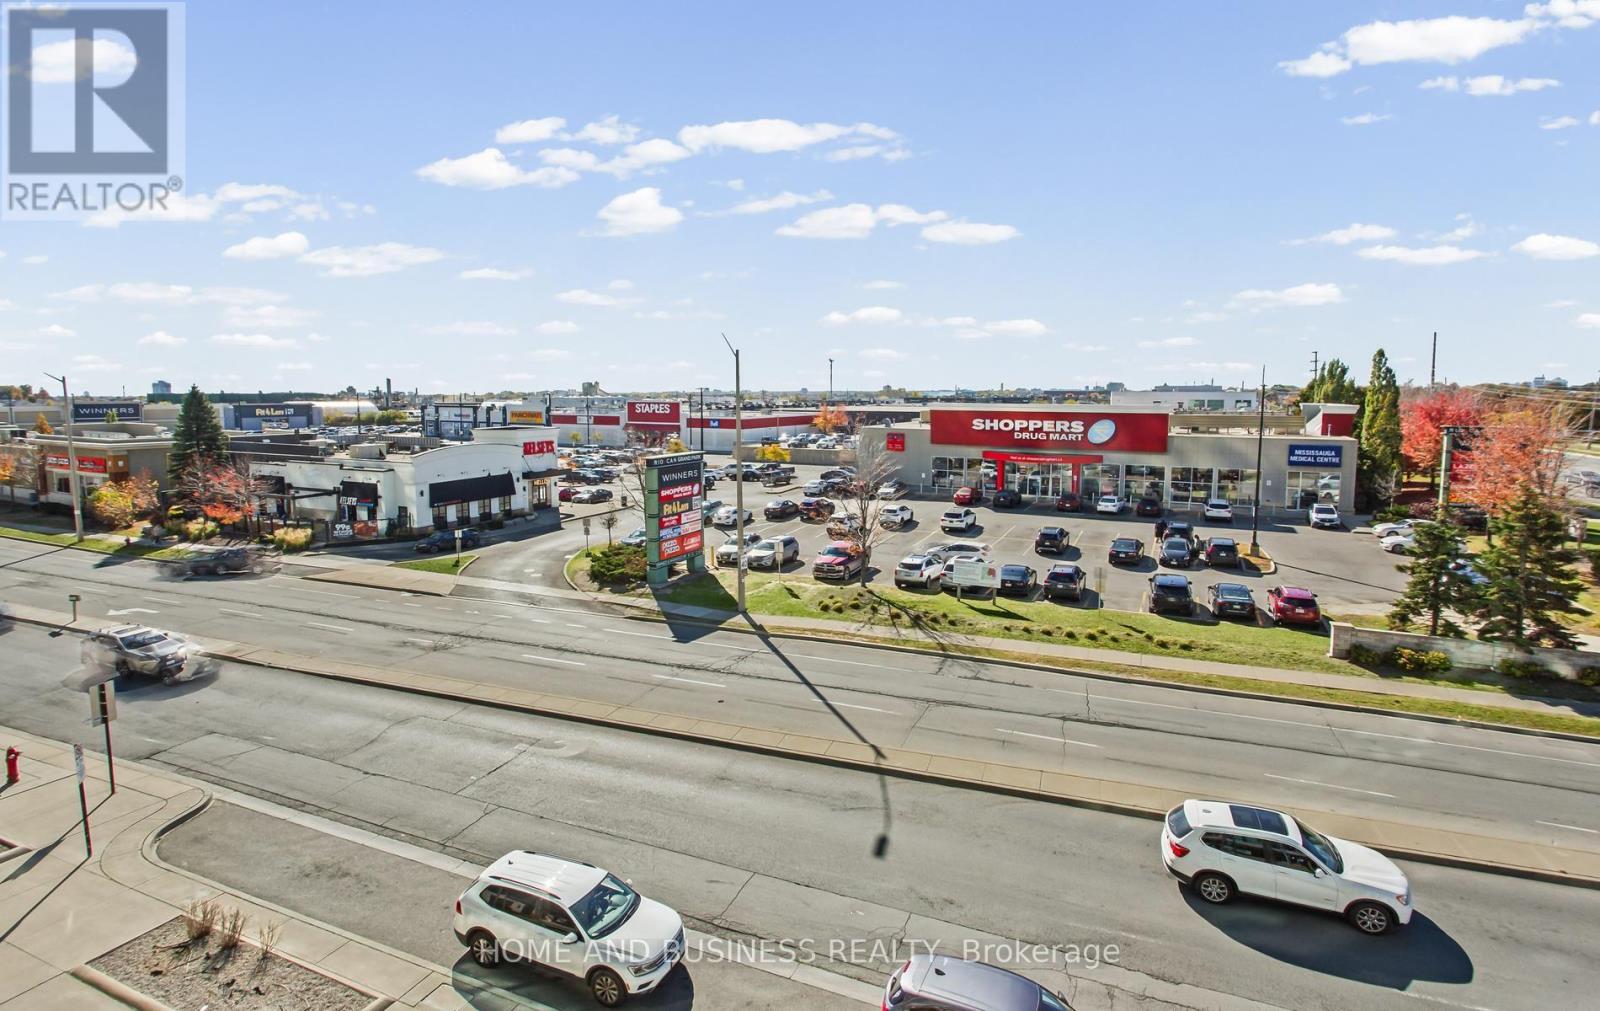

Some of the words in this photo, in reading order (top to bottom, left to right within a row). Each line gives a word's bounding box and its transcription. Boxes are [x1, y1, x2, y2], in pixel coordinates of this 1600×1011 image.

[635, 403, 671, 414] STAPLES
[971, 418, 1085, 433] SHOPPERS
[1014, 432, 1047, 440] DRUG
[1049, 433, 1084, 441] MART
[1294, 449, 1336, 457] MISSISSAUGA
[662, 470, 698, 481] WINNERS
[661, 486, 692, 497] SHOPPERS
